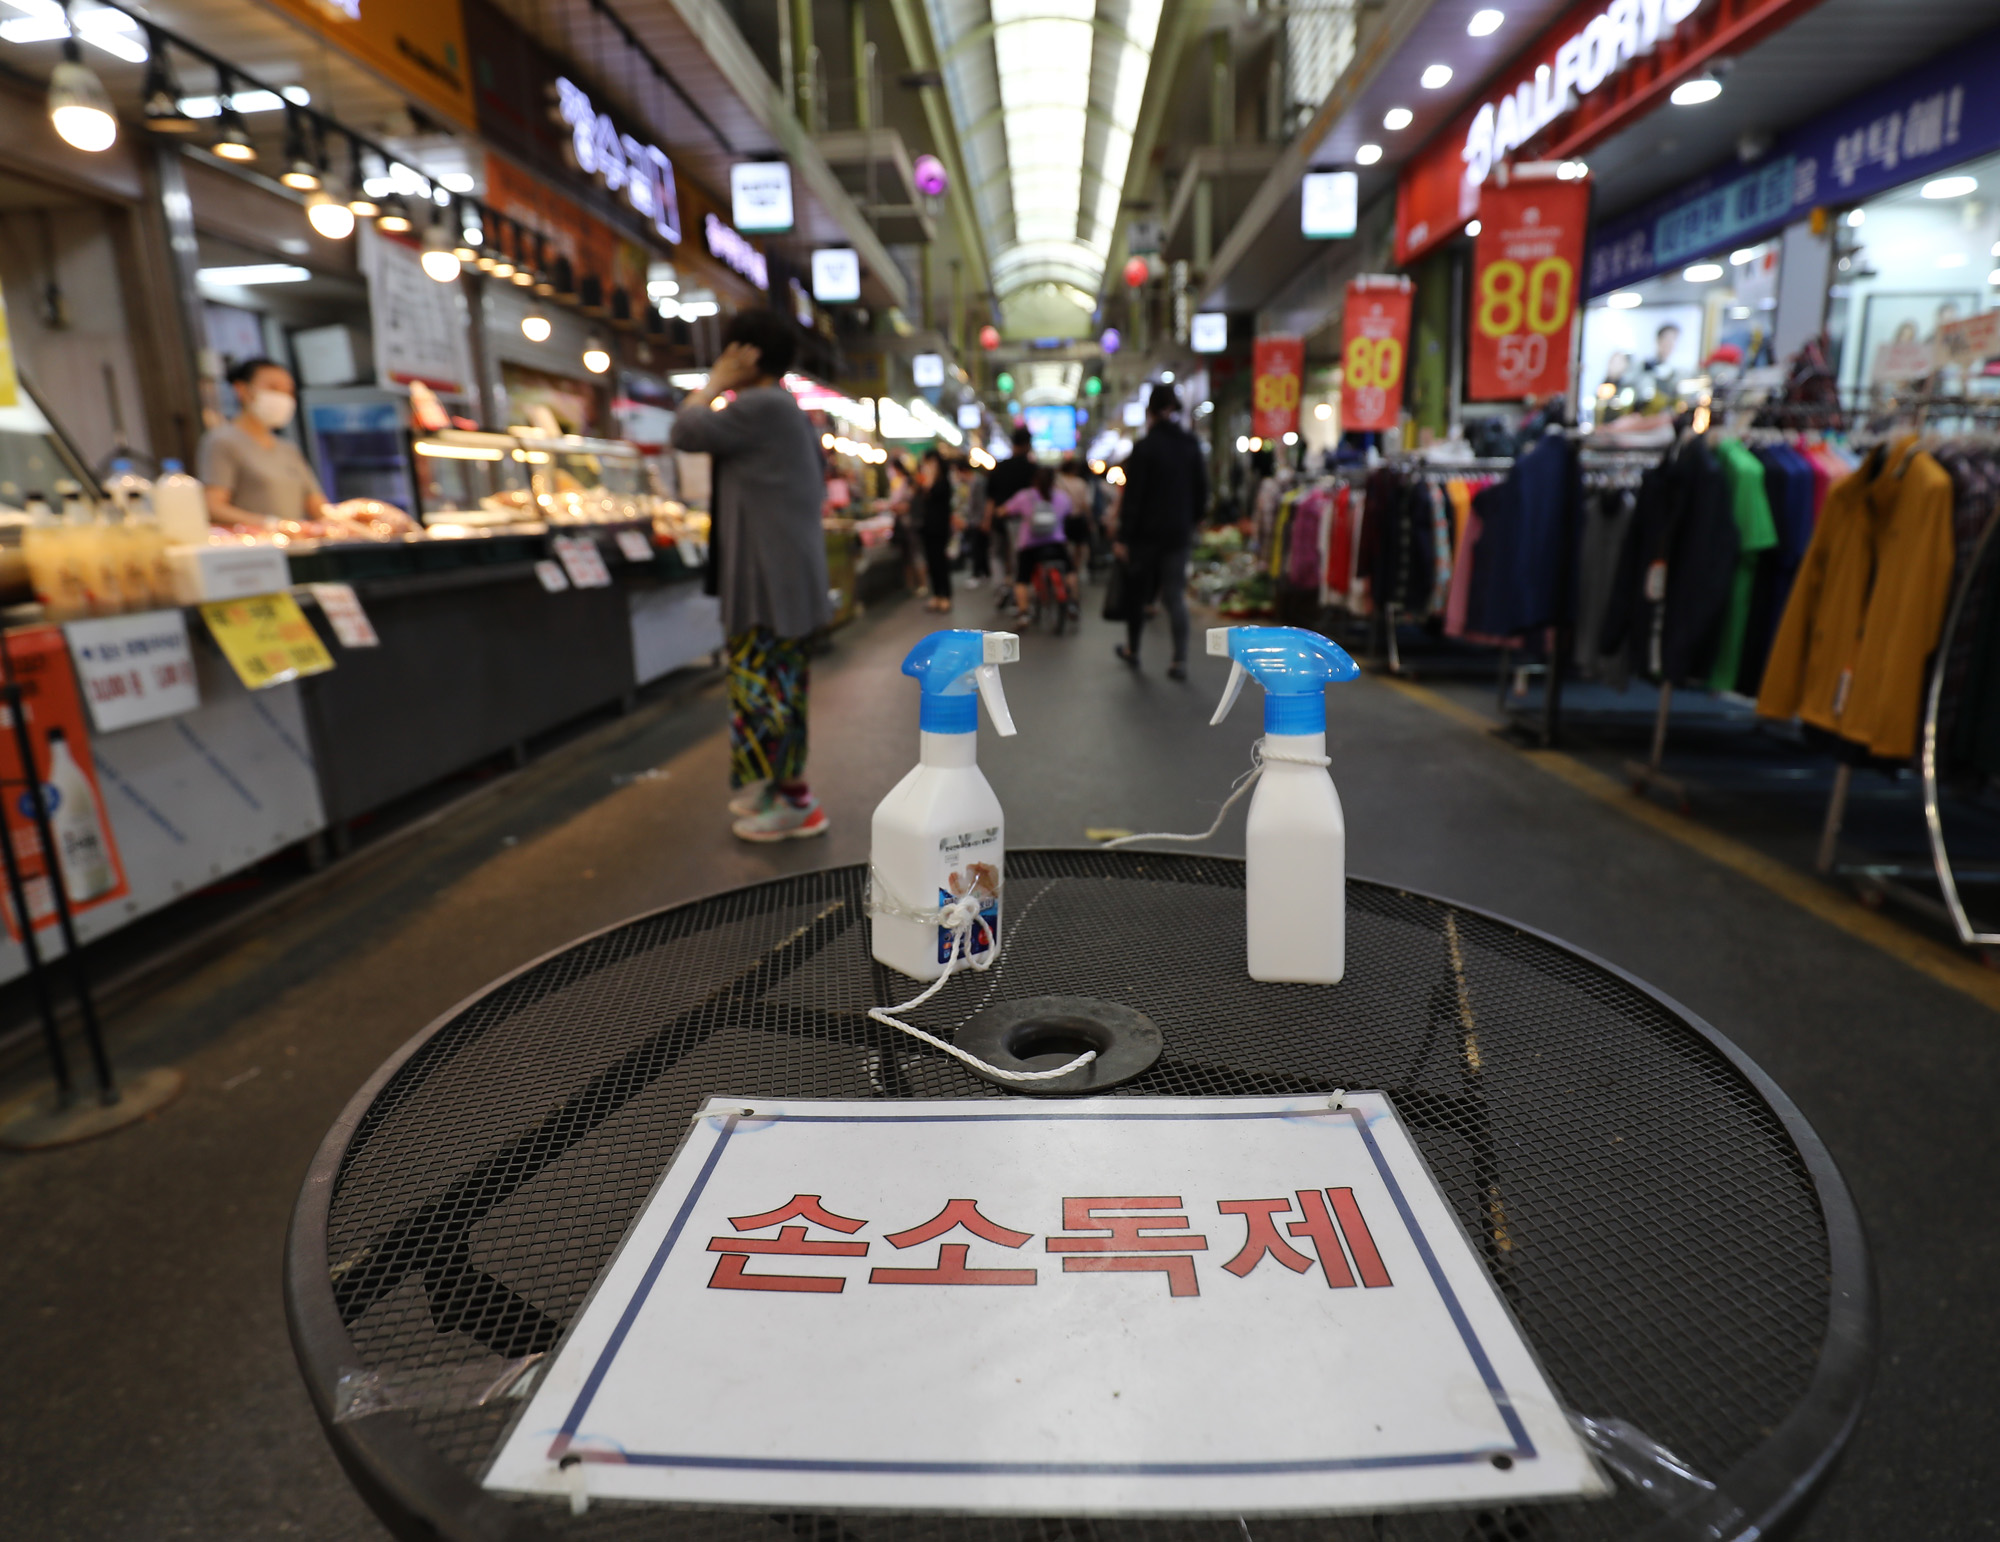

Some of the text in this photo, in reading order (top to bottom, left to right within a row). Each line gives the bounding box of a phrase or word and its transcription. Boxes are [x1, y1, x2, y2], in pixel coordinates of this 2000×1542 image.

[1479, 255, 1573, 338] 80
[1346, 335, 1402, 391] 80
[1496, 334, 1548, 379] 50
[1255, 374, 1299, 412] 80
[706, 1187, 1393, 1298] 손소독제
